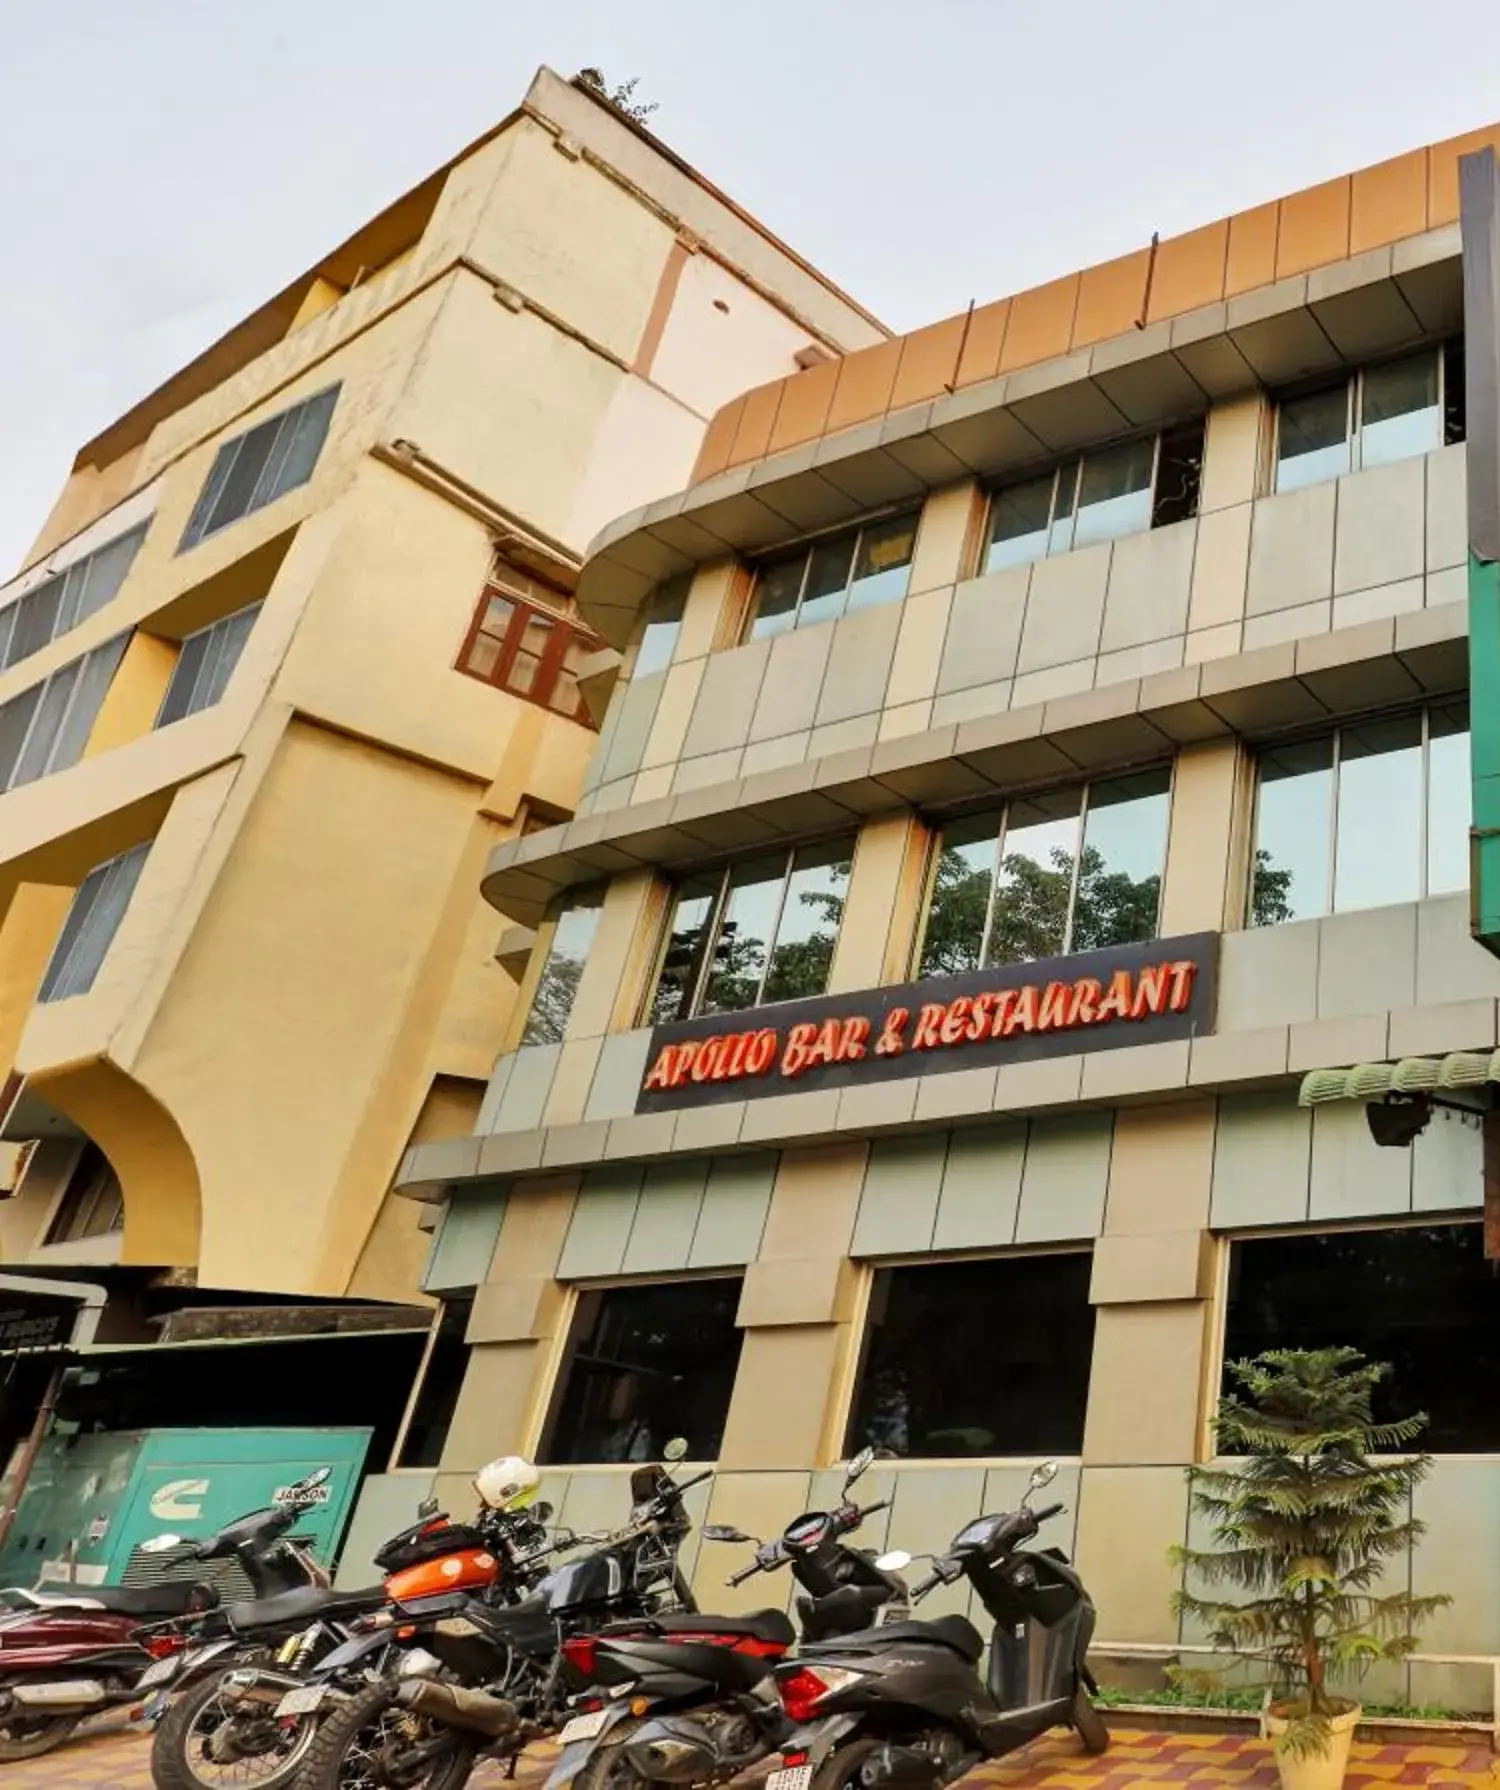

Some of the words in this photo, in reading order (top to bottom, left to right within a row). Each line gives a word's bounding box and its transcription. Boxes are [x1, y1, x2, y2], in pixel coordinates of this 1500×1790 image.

[643, 1027, 778, 1092] APOLLO
[780, 1016, 871, 1079] BAR
[875, 1007, 909, 1056] &
[912, 960, 1197, 1050] RESTAURANT
